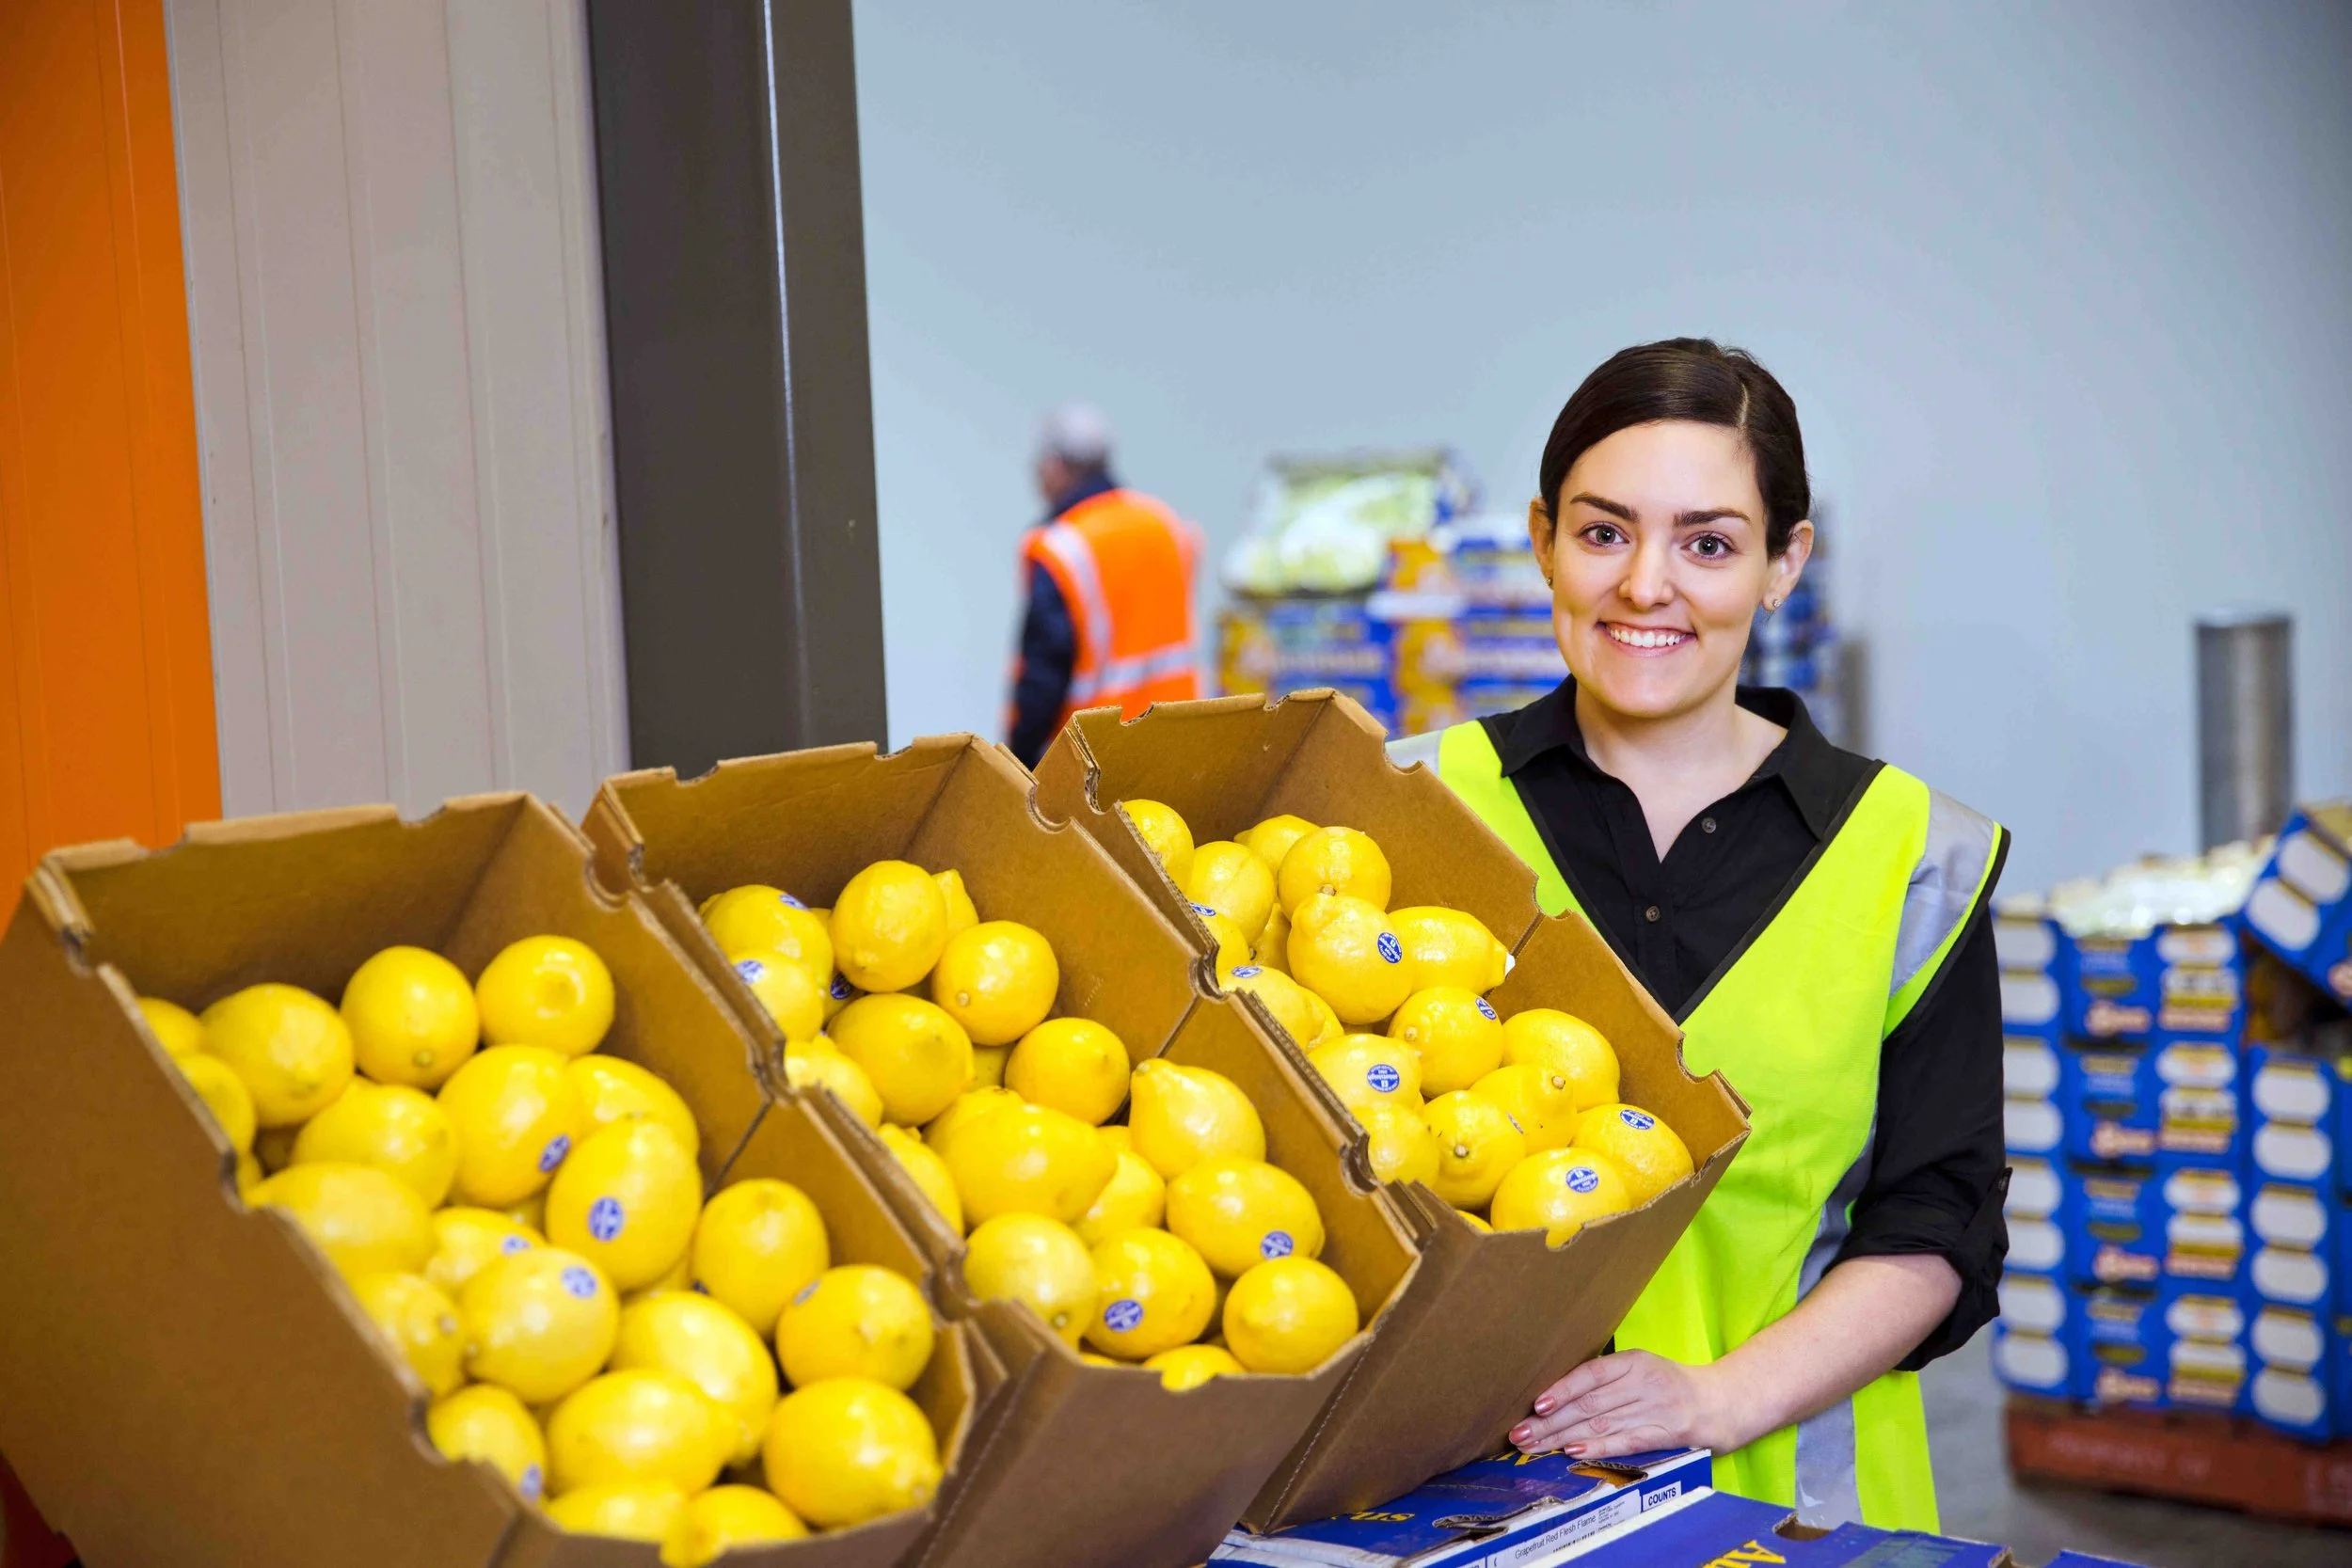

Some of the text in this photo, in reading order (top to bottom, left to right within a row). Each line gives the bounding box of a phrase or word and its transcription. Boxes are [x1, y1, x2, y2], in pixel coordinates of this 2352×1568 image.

[1648, 1487, 1677, 1506] COUNTS
[1515, 1539, 1545, 1559] Grapefruit
[1546, 1532, 1559, 1544] Red
[1559, 1525, 1576, 1537] Flesh
[1577, 1515, 1596, 1529] Flame
